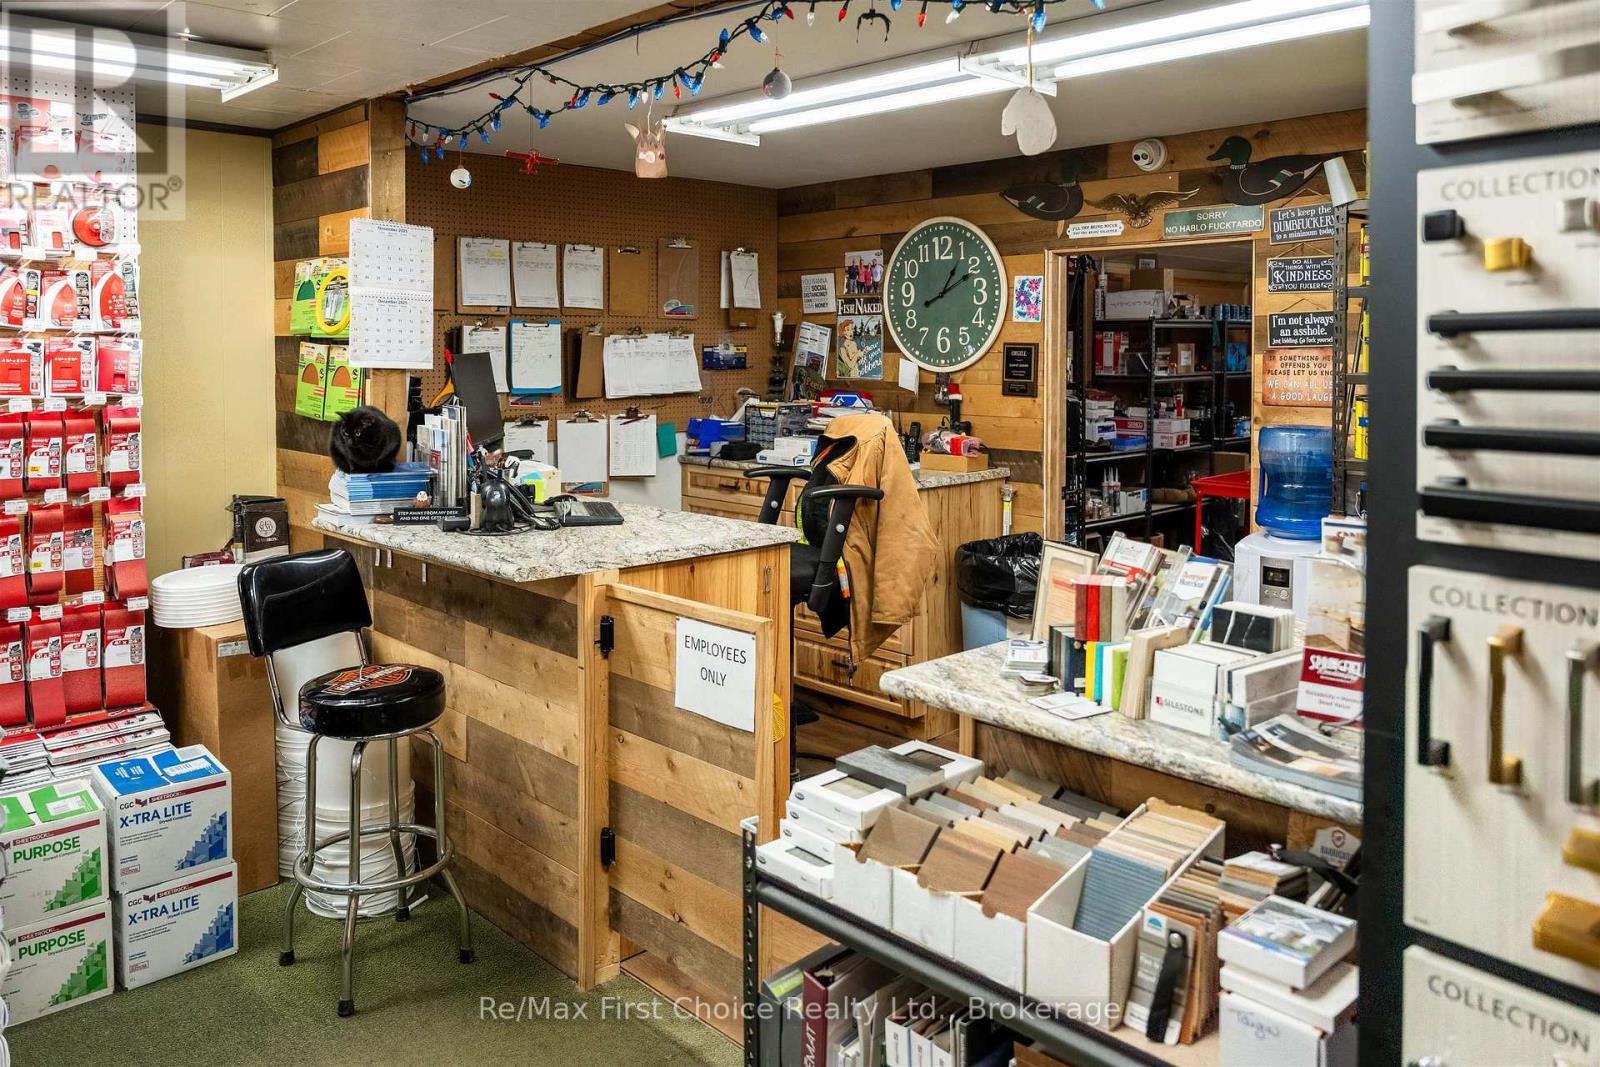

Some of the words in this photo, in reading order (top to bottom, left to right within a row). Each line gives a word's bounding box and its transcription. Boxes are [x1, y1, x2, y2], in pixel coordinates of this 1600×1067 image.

[1197, 211, 1227, 221] SORRY
[1278, 210, 1295, 220] Let's
[1297, 208, 1315, 217] keep
[1318, 205, 1331, 213] the
[1179, 223, 1206, 232] HABLO
[1208, 219, 1261, 231] FUCKTARDO
[1288, 230, 1317, 238] minimum
[918, 244, 929, 262] 11
[932, 236, 953, 260] 12
[958, 241, 965, 260] 1
[904, 259, 919, 278] 10
[968, 256, 981, 274] 2
[1273, 269, 1332, 283] KINDNESS
[901, 281, 915, 307] 9
[973, 277, 988, 305] 3
[905, 309, 917, 328] 8
[972, 307, 985, 328] 4
[1272, 315, 1286, 327] I'm
[1288, 315, 1303, 326] not
[1304, 313, 1334, 326] always
[919, 327, 929, 345] 7
[936, 327, 951, 353] 6
[959, 326, 970, 345] 5
[1280, 328, 1291, 336] an
[1293, 325, 1328, 336] asshole.
[1268, 380, 1279, 389] WE
[1280, 392, 1303, 400] GOOD
[1429, 585, 1599, 628] COLLECTION
[684, 635, 747, 664] EMPLOYEES
[700, 666, 727, 687] ONLY
[119, 802, 134, 810] CGC
[120, 809, 161, 828] X-TRA
[164, 802, 192, 818] LITE
[13, 836, 80, 863] PURPOSE
[128, 899, 142, 907] CGC
[128, 905, 169, 926] X-TRA
[172, 895, 199, 912] LITE
[18, 929, 86, 960] PURPOSE
[1428, 975, 1591, 1053] COLLECTION
